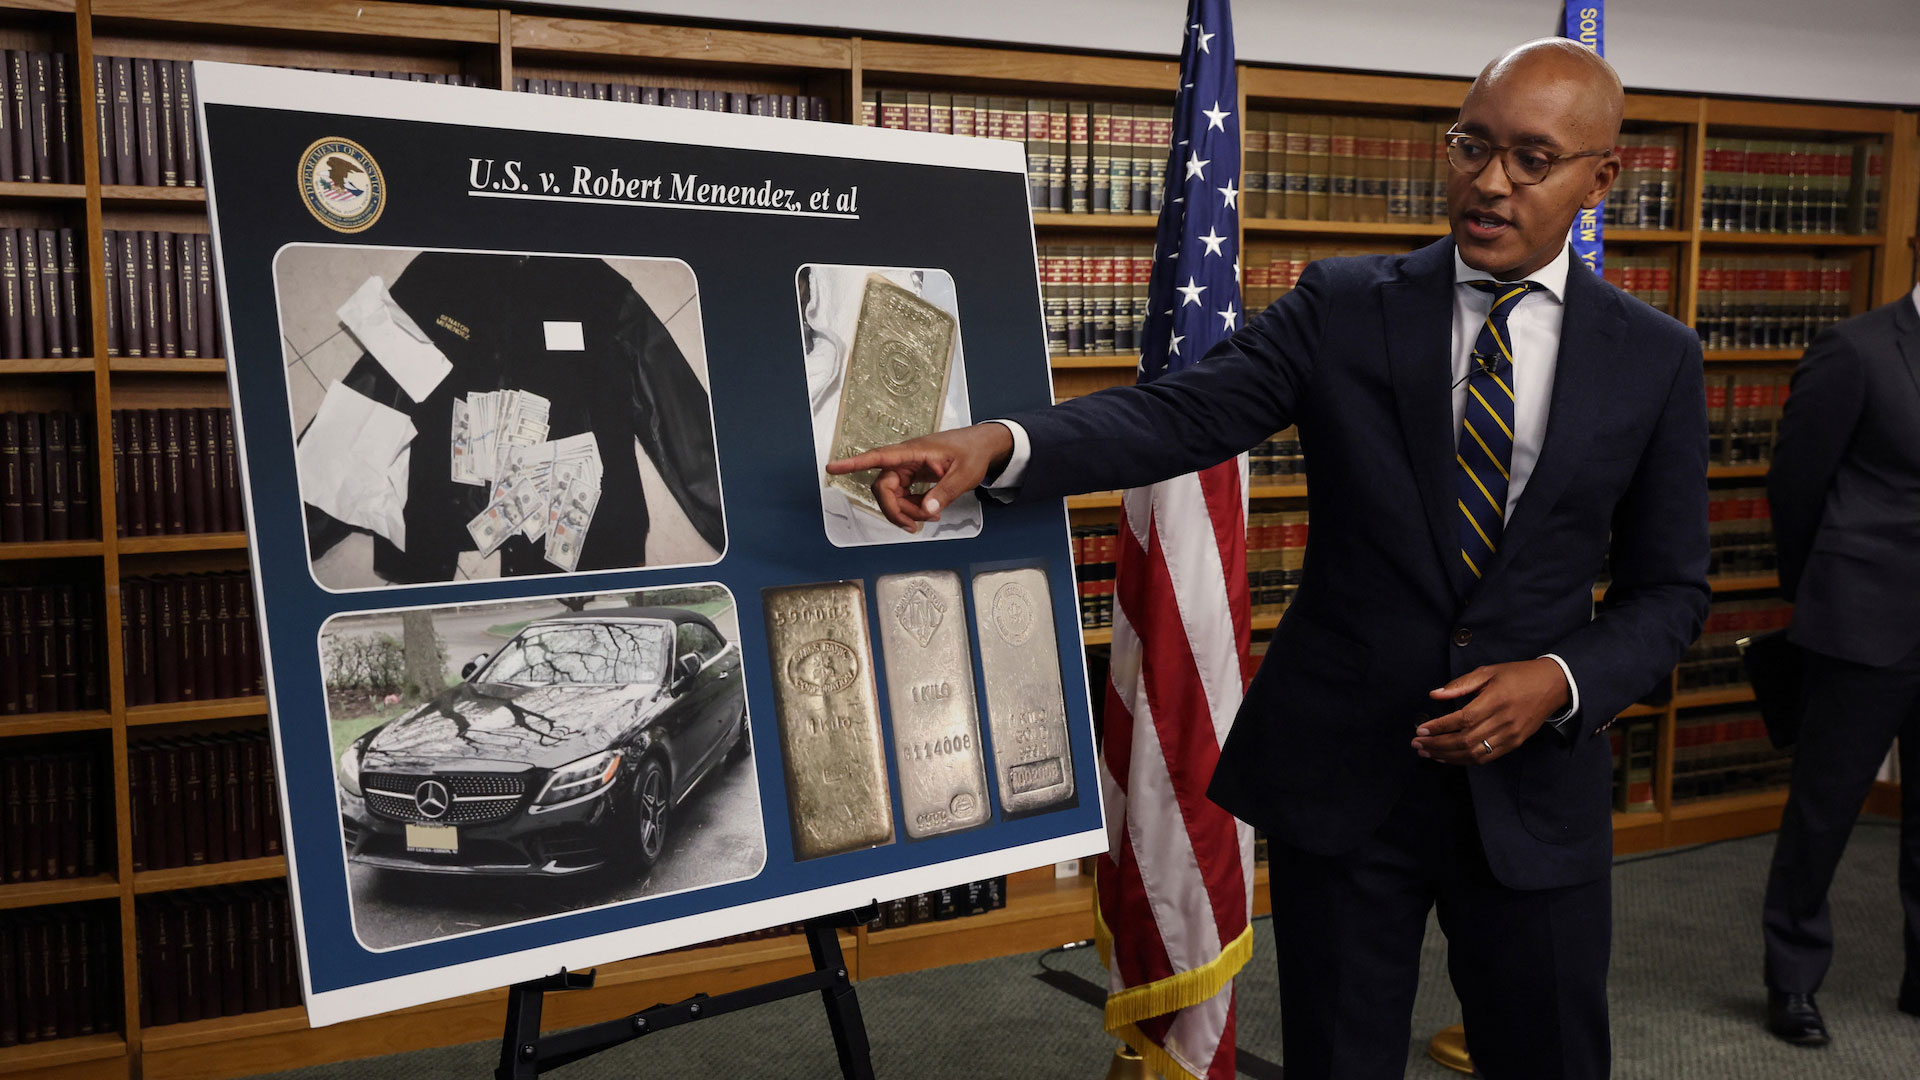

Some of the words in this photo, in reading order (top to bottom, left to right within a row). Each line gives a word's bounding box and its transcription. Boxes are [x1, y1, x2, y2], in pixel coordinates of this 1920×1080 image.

[304, 144, 341, 194] DEPARTMENT
[343, 146, 356, 157] OF
[358, 155, 380, 198] JUSTICE
[468, 157, 530, 192] U.S.
[538, 171, 561, 194] v.
[569, 164, 662, 201] Robert
[670, 172, 802, 213] Menendez,
[809, 188, 831, 211] et
[836, 186, 858, 213] al
[1579, 208, 1597, 242] NEW
[440, 314, 470, 334] SENATOR
